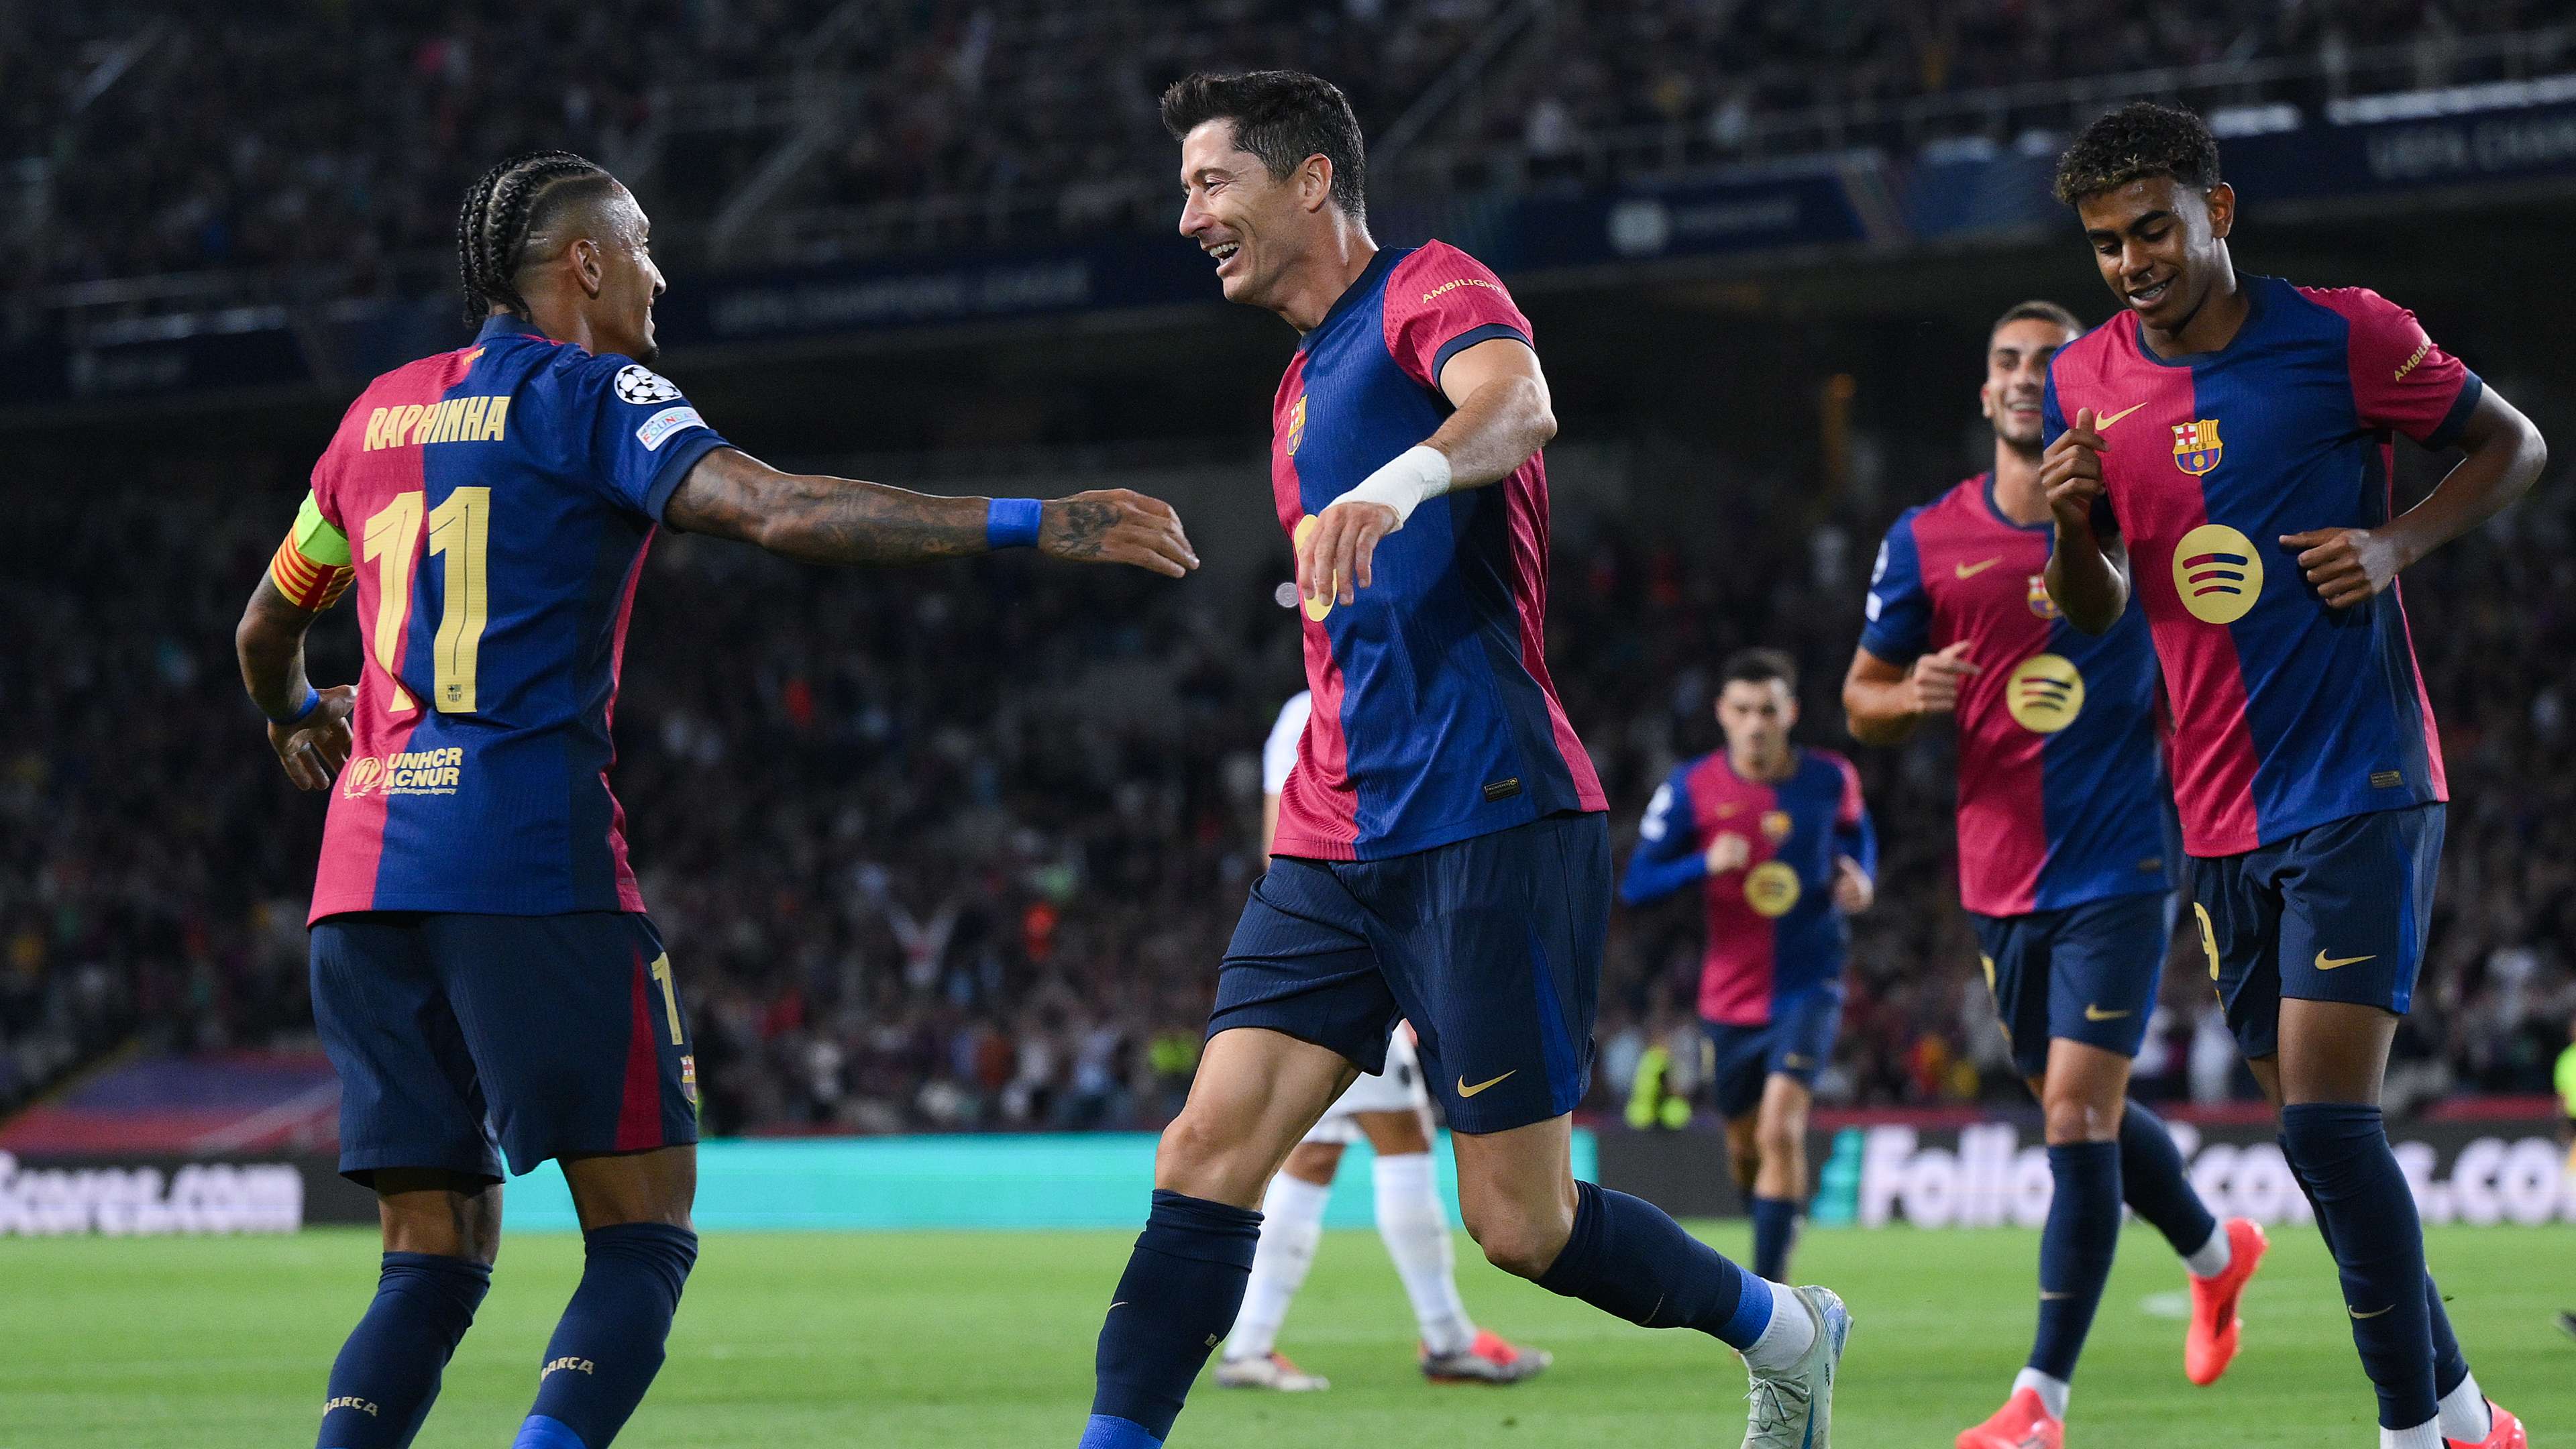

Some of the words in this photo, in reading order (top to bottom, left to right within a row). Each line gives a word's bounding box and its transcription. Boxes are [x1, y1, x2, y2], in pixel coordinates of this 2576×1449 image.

[363, 396, 511, 451] RAPHINHA
[363, 486, 492, 714] 11
[382, 767, 460, 788] ACNUR
[386, 747, 463, 769] UNHCR
[0, 1148, 305, 1236] cores.com
